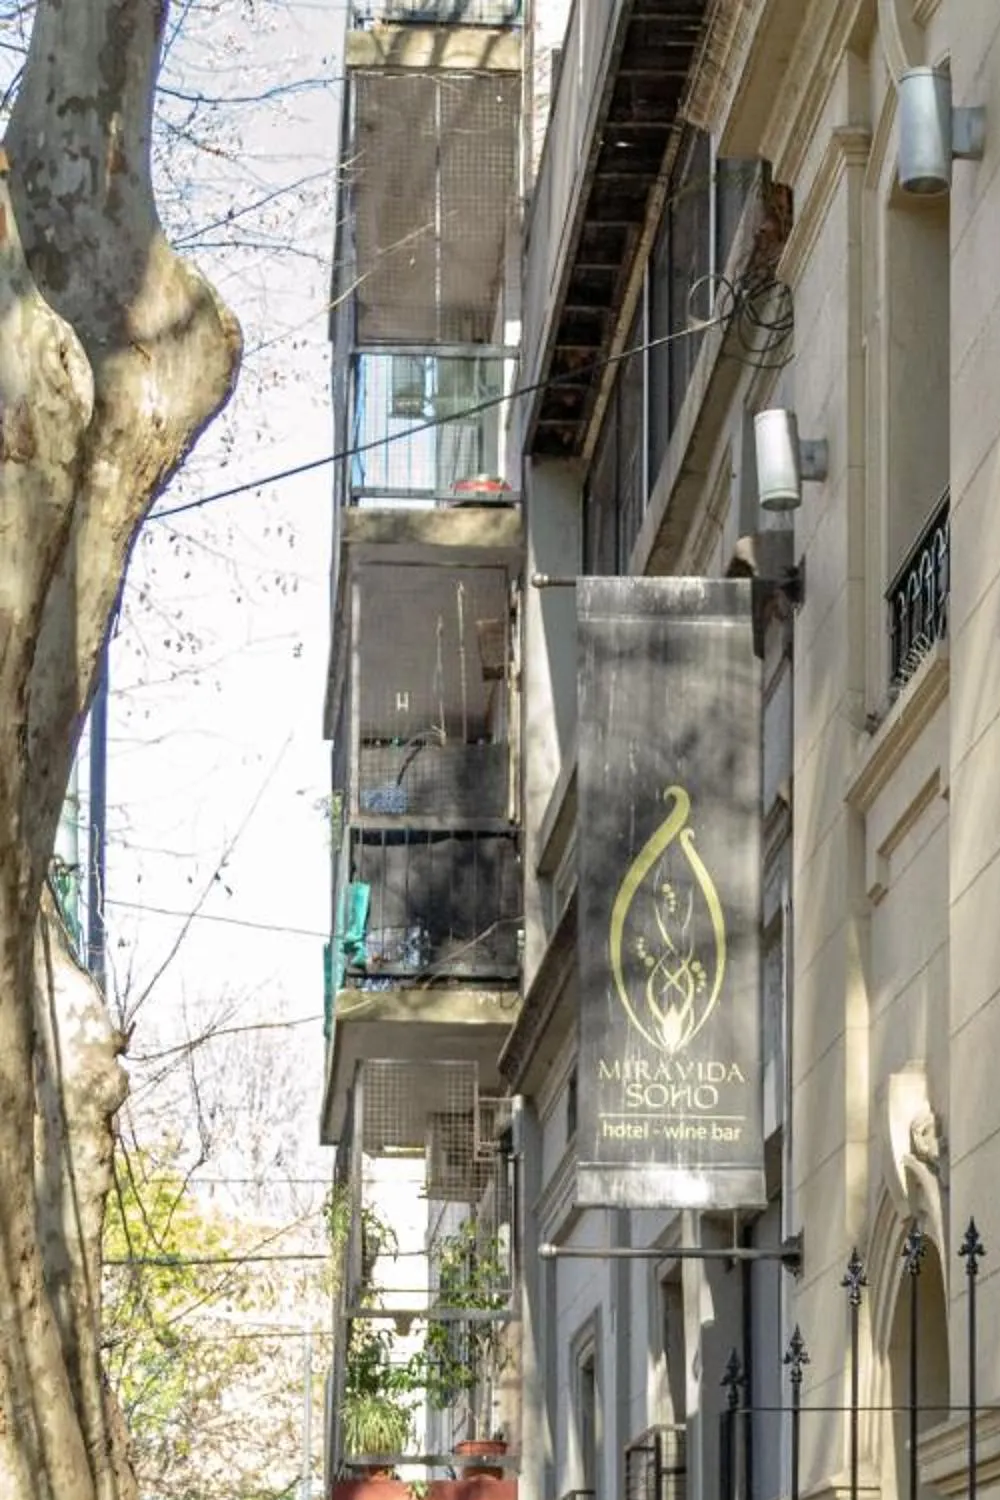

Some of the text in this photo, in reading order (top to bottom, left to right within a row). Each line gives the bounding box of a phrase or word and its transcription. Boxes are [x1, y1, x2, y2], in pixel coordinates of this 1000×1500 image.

[598, 1058, 746, 1083] MIRAVIDA
[625, 1083, 719, 1109] SOHO
[603, 1119, 649, 1140] hotel
[663, 1121, 706, 1140] wine
[711, 1122, 743, 1141] bar
